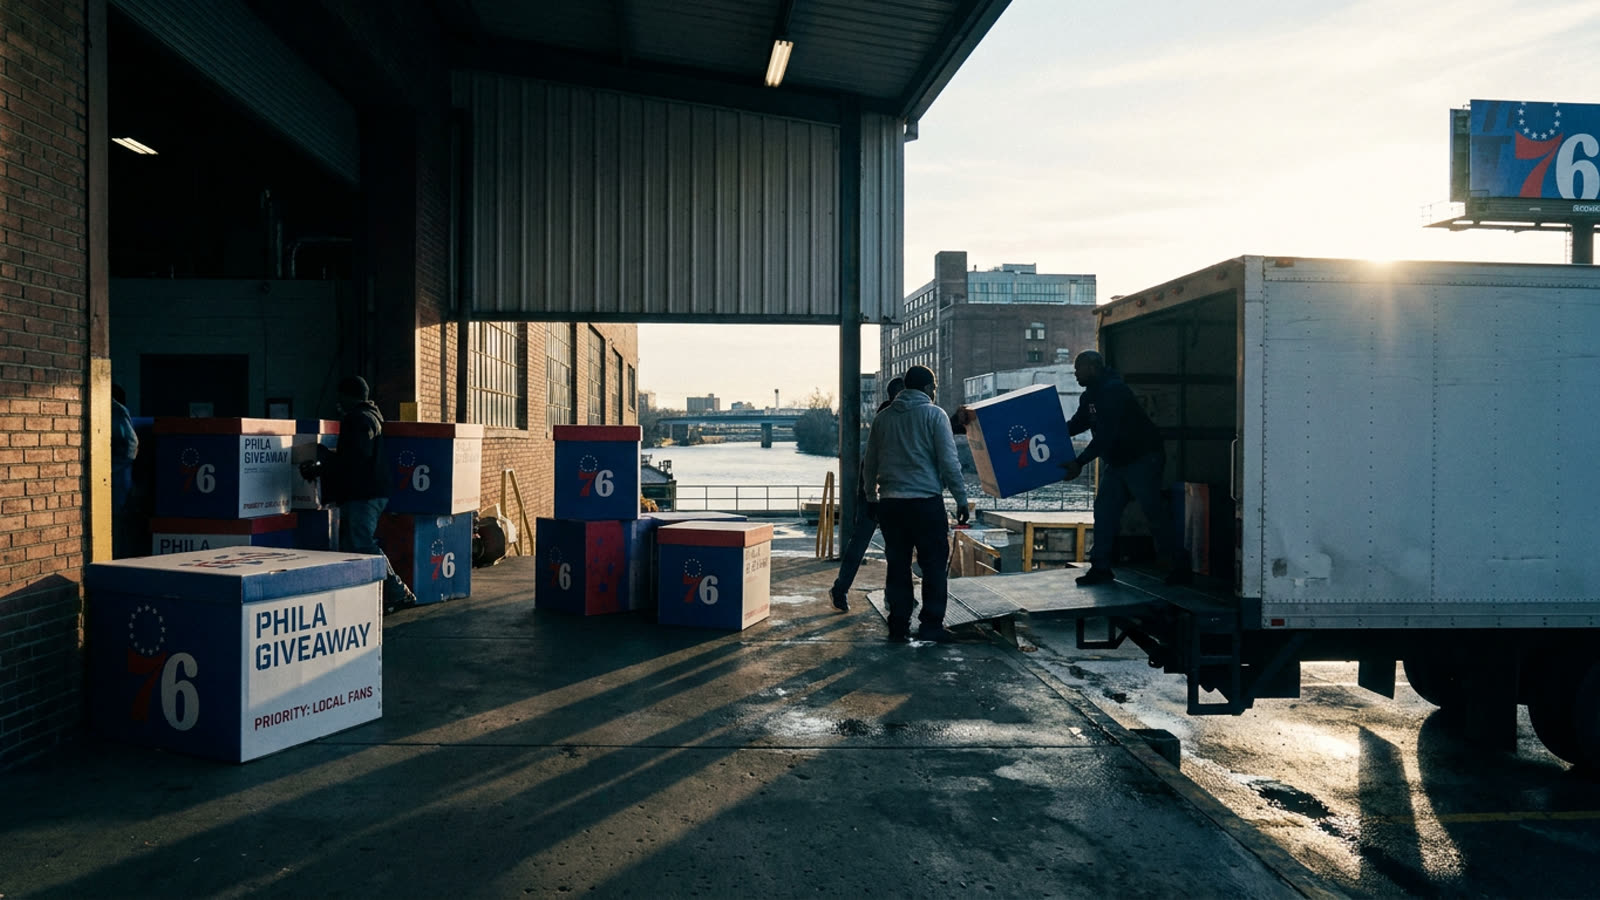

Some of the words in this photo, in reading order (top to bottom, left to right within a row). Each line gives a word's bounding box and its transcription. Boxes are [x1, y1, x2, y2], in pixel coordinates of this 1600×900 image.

[1515, 130, 1600, 200] 76
[244, 451, 288, 464] GIVEAWAY
[1010, 433, 1051, 470] 76
[179, 463, 216, 494] 76
[398, 464, 431, 492] 76
[577, 469, 614, 498] 76
[430, 552, 456, 580] 76
[549, 562, 572, 591] 76
[682, 573, 719, 605] 76
[256, 603, 327, 639] PHILA
[256, 622, 371, 671] GIVEAWAY
[127, 647, 200, 732] 76
[254, 704, 310, 731] PRIORITY:
[313, 697, 345, 715] LOCAL
[349, 686, 373, 704] FANS
